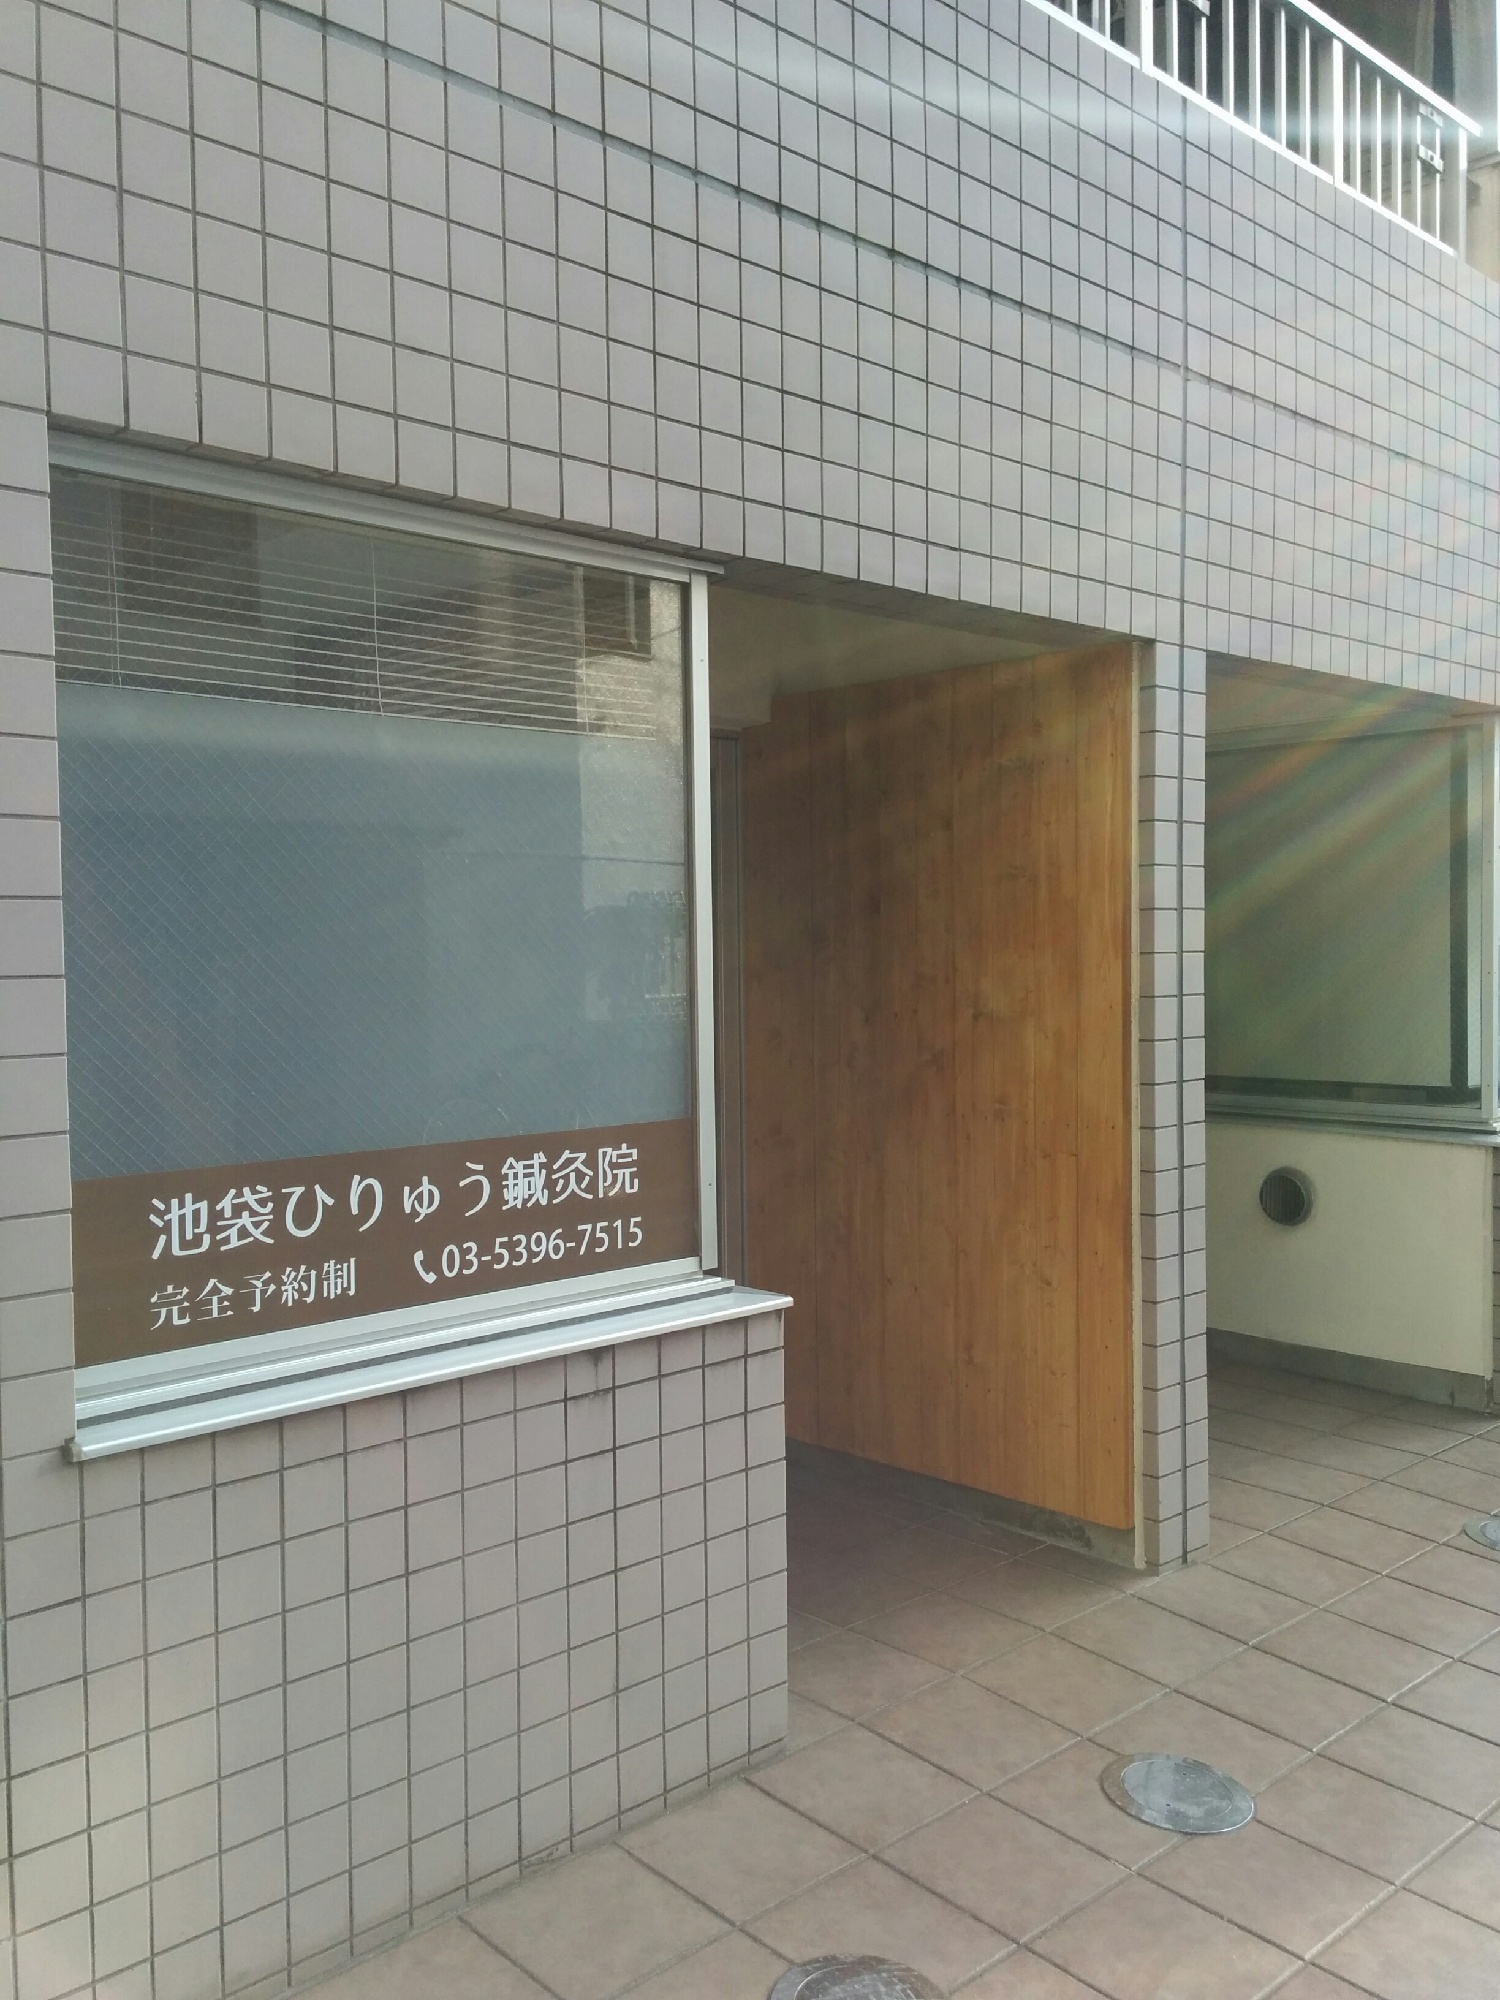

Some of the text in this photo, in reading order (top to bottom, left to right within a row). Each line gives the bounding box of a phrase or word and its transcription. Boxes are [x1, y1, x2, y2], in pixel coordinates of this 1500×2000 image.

[148, 1143, 639, 1259] 池袋ひりゅう鍼灸院
[441, 1216, 643, 1278] 03-5396-7515
[150, 1257, 356, 1330] 完全予約制
